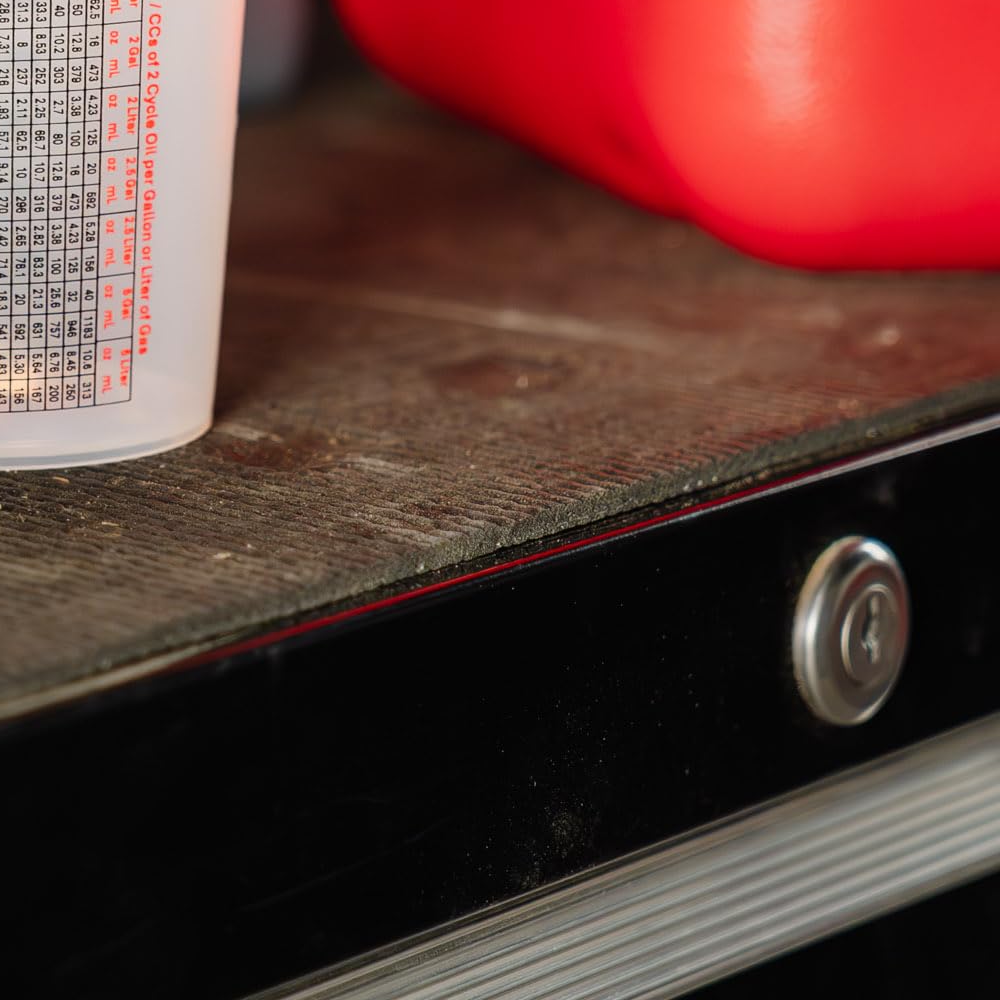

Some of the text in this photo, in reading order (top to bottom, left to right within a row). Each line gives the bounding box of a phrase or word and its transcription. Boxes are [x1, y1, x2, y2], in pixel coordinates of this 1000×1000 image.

[17, 2, 29, 22] 31.3
[54, 5, 65, 17] 40
[110, 31, 119, 44] oz
[149, 14, 161, 47] CCs
[54, 33, 65, 54] 10.2
[129, 47, 139, 67] Gal
[148, 52, 160, 66] of
[16, 68, 28, 85] 237
[53, 66, 64, 84] 303
[88, 64, 99, 82] 473
[110, 60, 120, 78] mL
[16, 99, 28, 118] 2.11
[88, 95, 98, 116] 4.23
[109, 95, 117, 108] oz
[144, 84, 159, 128] Cycle
[127, 108, 138, 134] Liter
[70, 130, 81, 147] 100
[108, 123, 119, 141] mL
[146, 133, 158, 155] Oil
[87, 163, 97, 174] 20
[107, 158, 116, 171] oz
[143, 160, 154, 184] per
[107, 186, 117, 204] mL
[125, 180, 136, 200] Gal
[69, 193, 80, 211] 473
[143, 190, 155, 240] Gallon
[68, 223, 79, 244] 4.23
[105, 248, 116, 267] mL
[124, 239, 134, 265] Liter
[142, 246, 151, 260] or
[51, 258, 62, 275] 100
[141, 266, 152, 299] Liter
[84, 289, 94, 301] 40
[104, 310, 114, 328] mL
[140, 306, 150, 319] of
[139, 324, 151, 354] Gas
[120, 360, 130, 386] Liter
[82, 382, 92, 400] 313
[102, 376, 112, 394] mL
